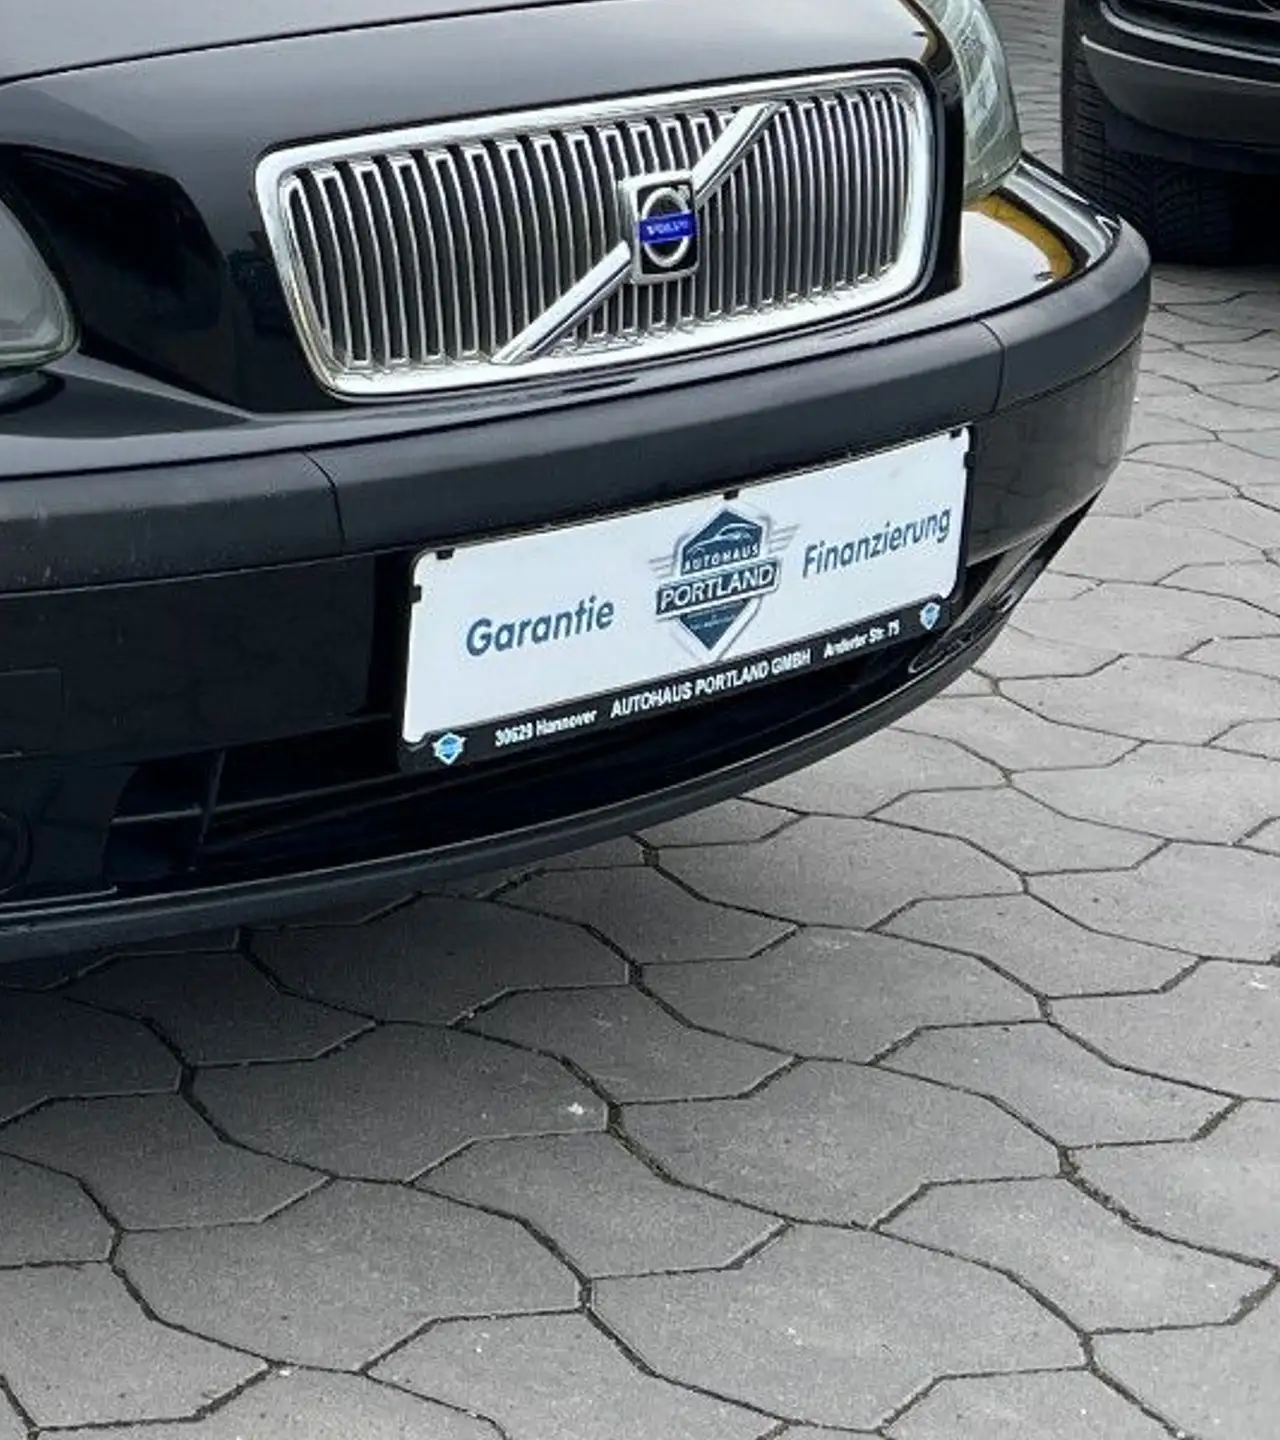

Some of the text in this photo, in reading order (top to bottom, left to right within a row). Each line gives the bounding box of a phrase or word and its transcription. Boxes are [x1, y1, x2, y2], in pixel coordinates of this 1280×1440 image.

[683, 543, 759, 573] AUTOHAUS
[802, 508, 952, 579] Finanzierung
[661, 564, 774, 610] PORTLAND
[466, 594, 614, 656] Garantie
[535, 709, 597, 737] Hannover
[610, 681, 692, 718] AUTOHAUS
[694, 661, 769, 697] PORTLAND
[771, 647, 811, 674] GMBH
